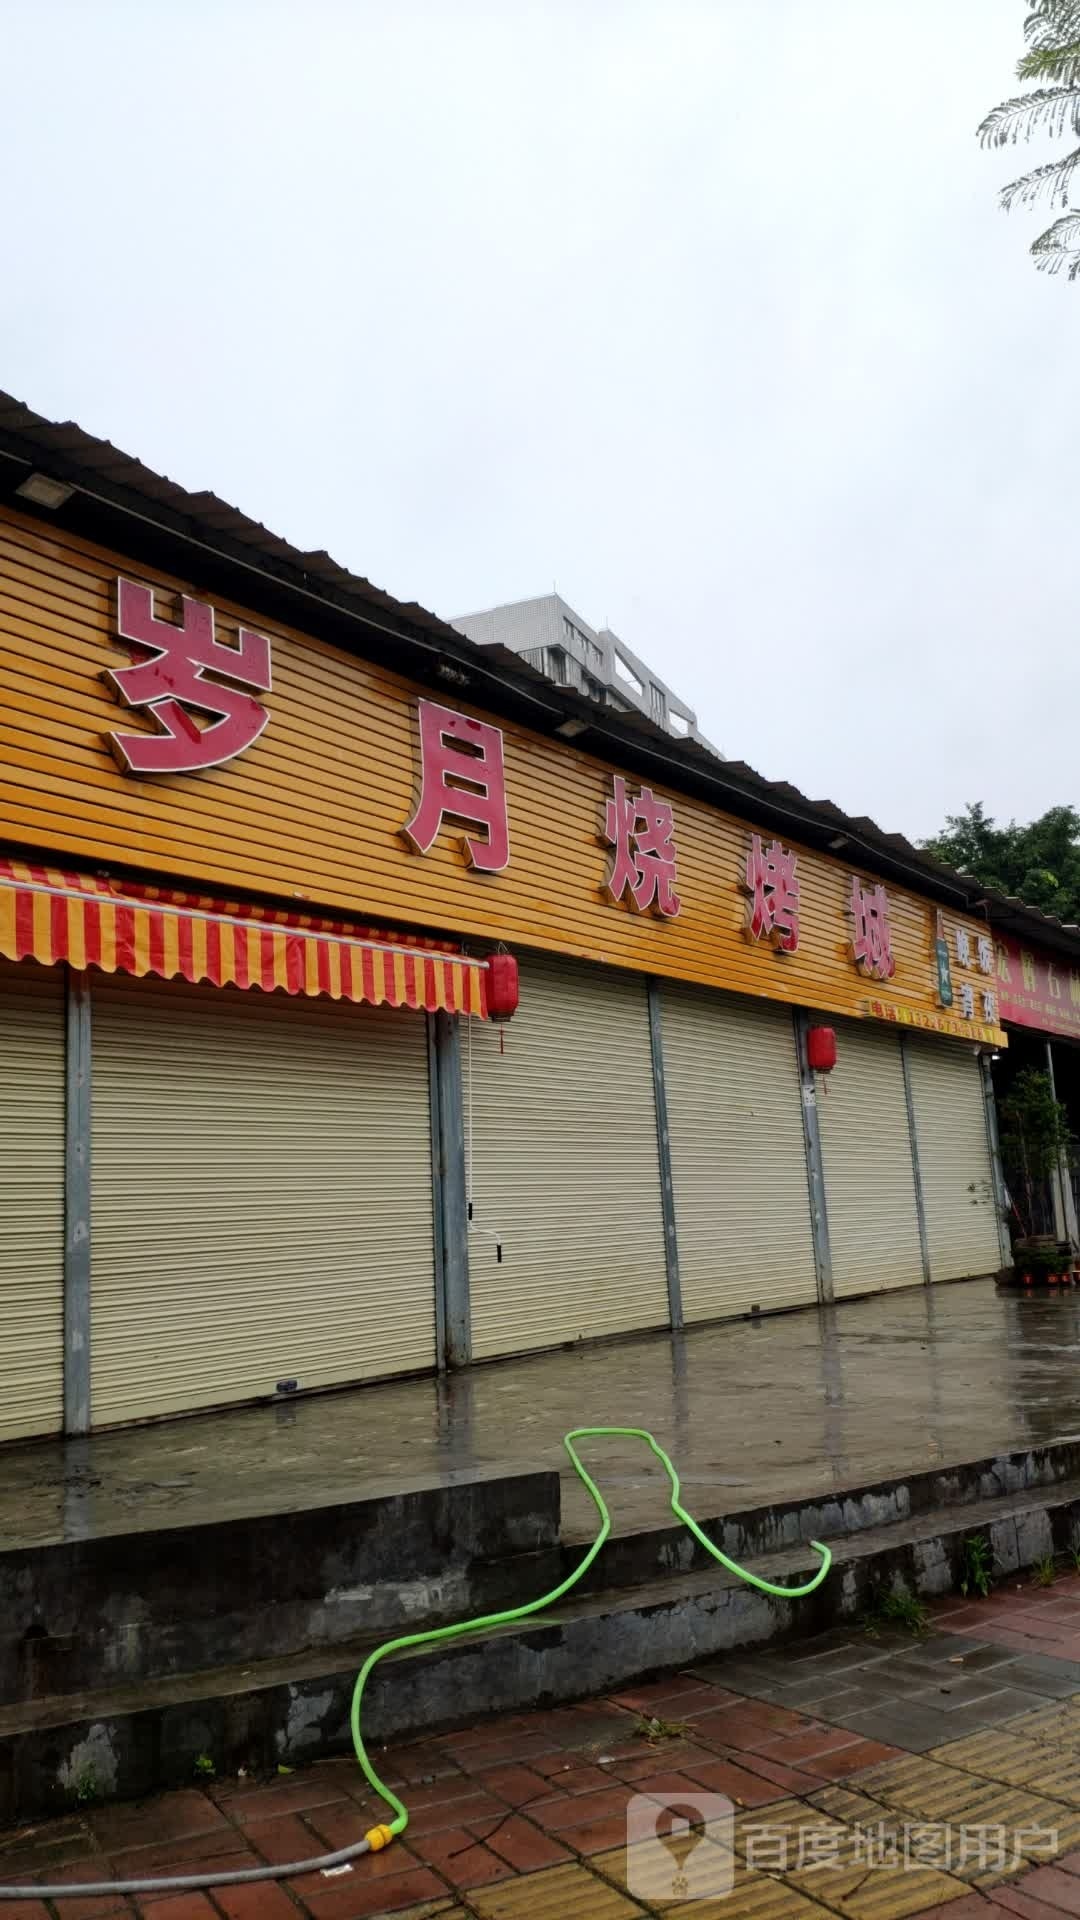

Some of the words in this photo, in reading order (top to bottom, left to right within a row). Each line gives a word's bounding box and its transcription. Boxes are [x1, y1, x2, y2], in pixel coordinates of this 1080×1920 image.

[102, 575, 897, 981] 岁月烧烤城
